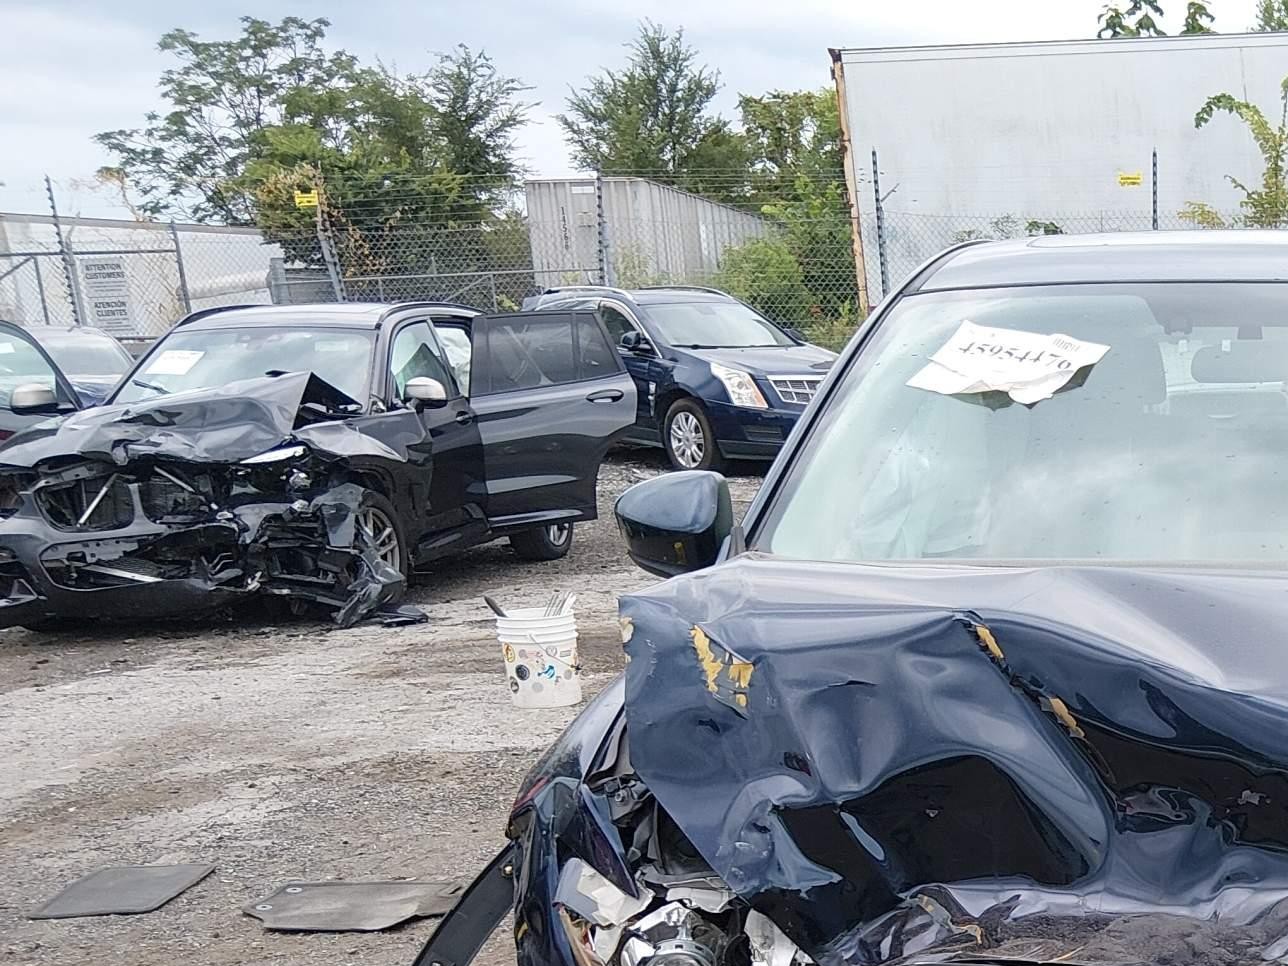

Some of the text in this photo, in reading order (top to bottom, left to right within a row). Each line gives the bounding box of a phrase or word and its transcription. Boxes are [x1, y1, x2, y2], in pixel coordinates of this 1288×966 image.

[84, 263, 122, 272] ATTENTION
[85, 271, 125, 280] CUSTOMERS
[96, 308, 128, 317] CLIENTES
